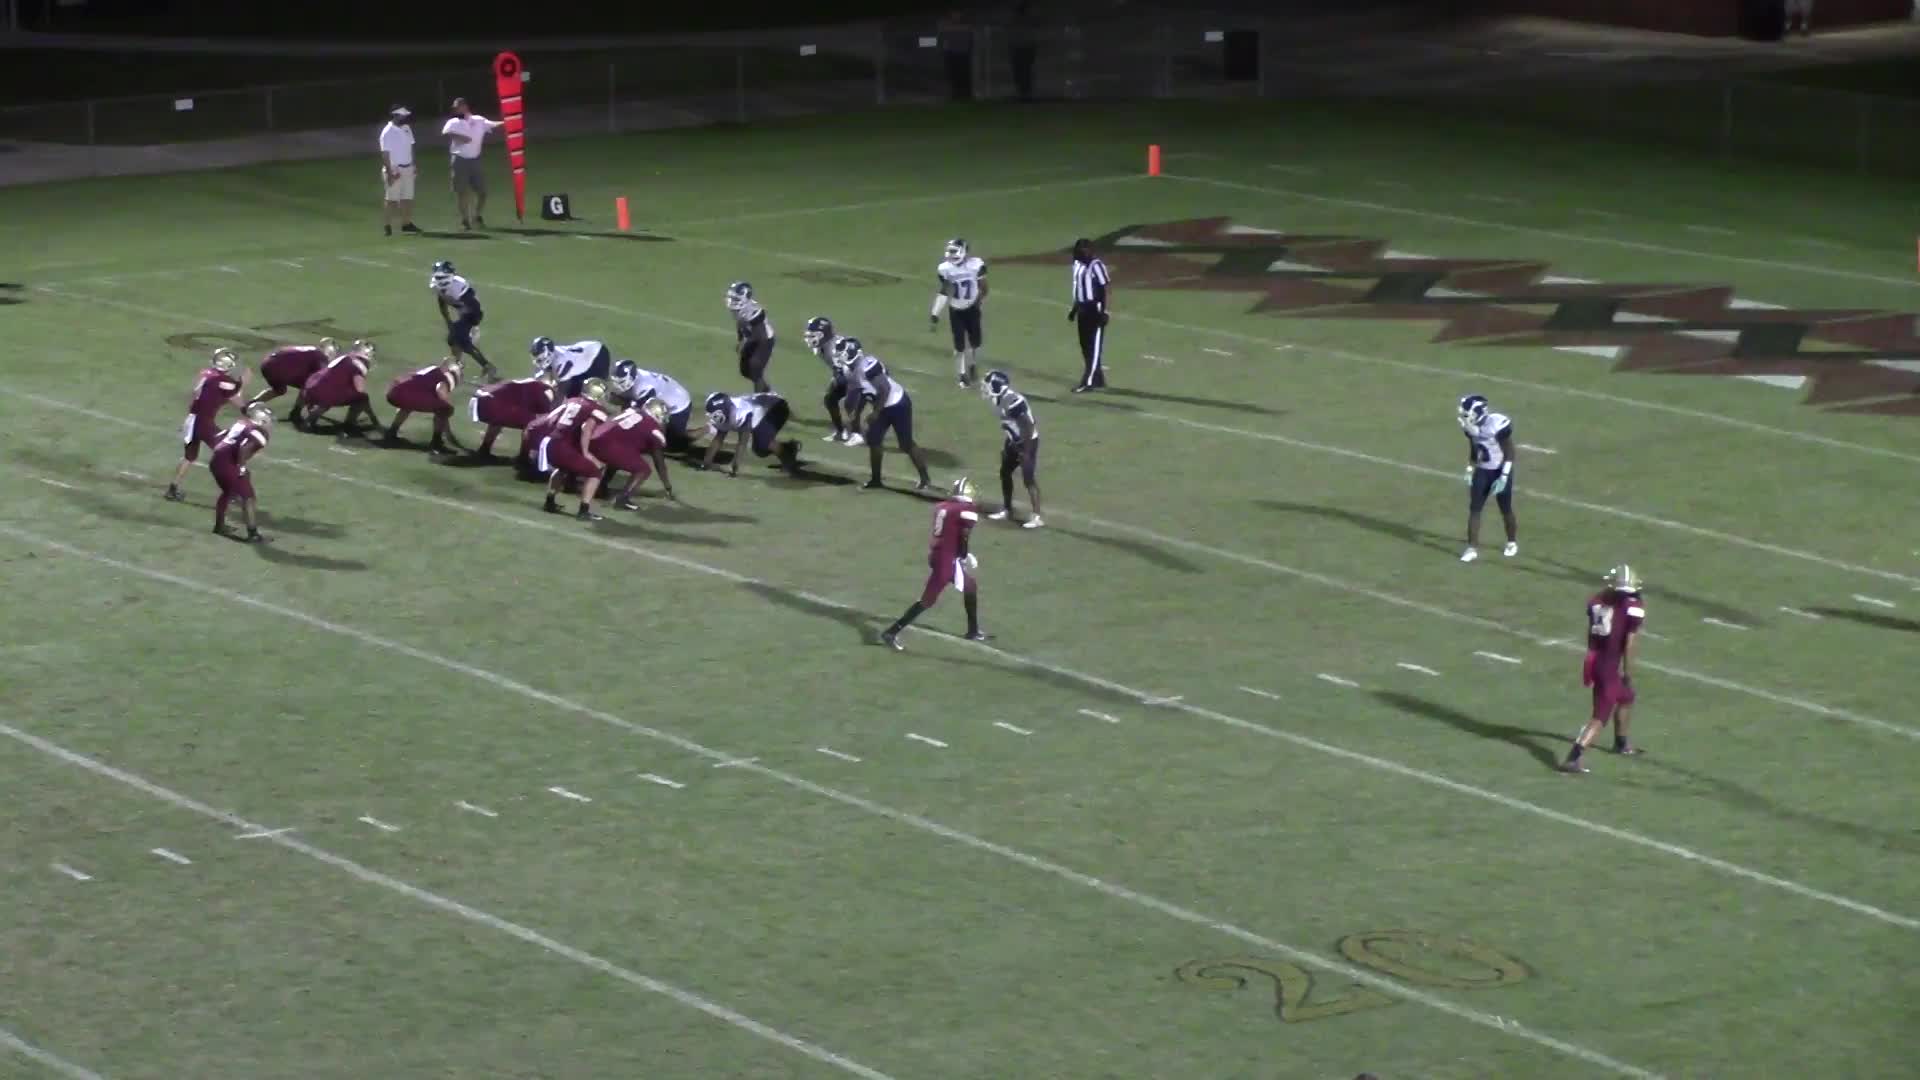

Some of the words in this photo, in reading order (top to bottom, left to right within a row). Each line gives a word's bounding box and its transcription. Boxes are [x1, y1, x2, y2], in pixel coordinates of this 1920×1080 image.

[550, 196, 564, 215] G
[952, 279, 972, 300] 17
[1174, 928, 1535, 1023] 20
